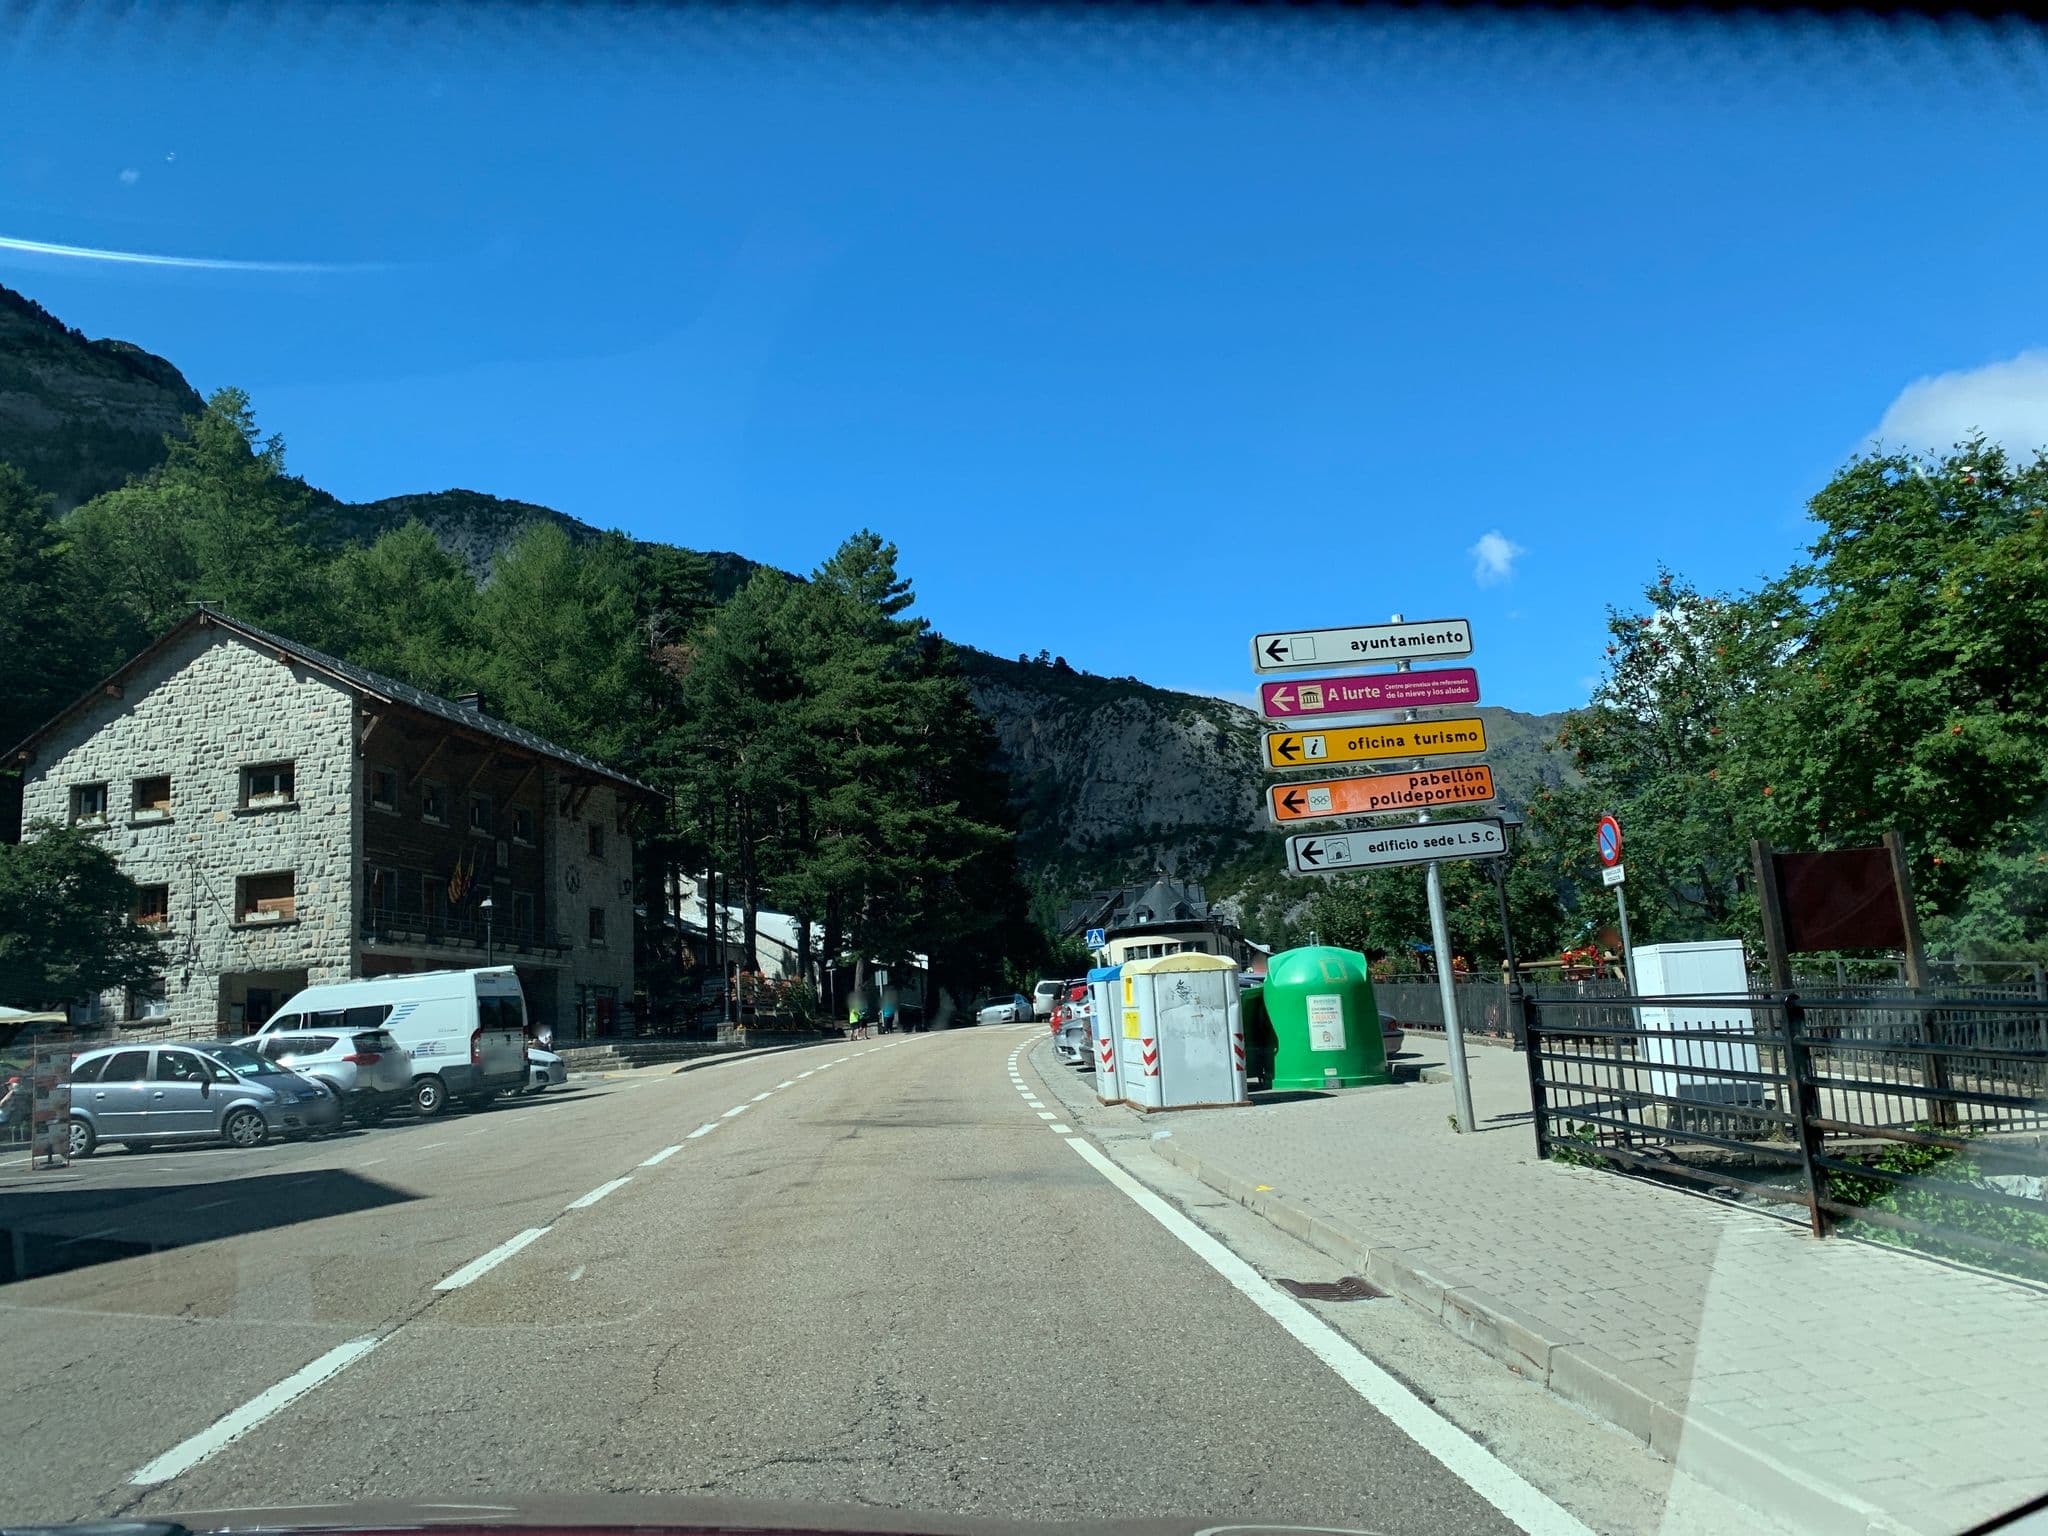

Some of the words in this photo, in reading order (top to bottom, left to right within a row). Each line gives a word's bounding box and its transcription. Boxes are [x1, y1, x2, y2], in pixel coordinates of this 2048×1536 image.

[1351, 631, 1463, 652] ayuntamiento
[1328, 688, 1340, 701] A
[1348, 736, 1404, 750] oficina
[1414, 730, 1478, 745] turismo
[1409, 769, 1484, 789] pabellón
[1370, 785, 1486, 808] polideportivo
[1368, 838, 1418, 853] edificio
[1423, 835, 1454, 848] sede
[1459, 831, 1500, 844] L.S.C.
